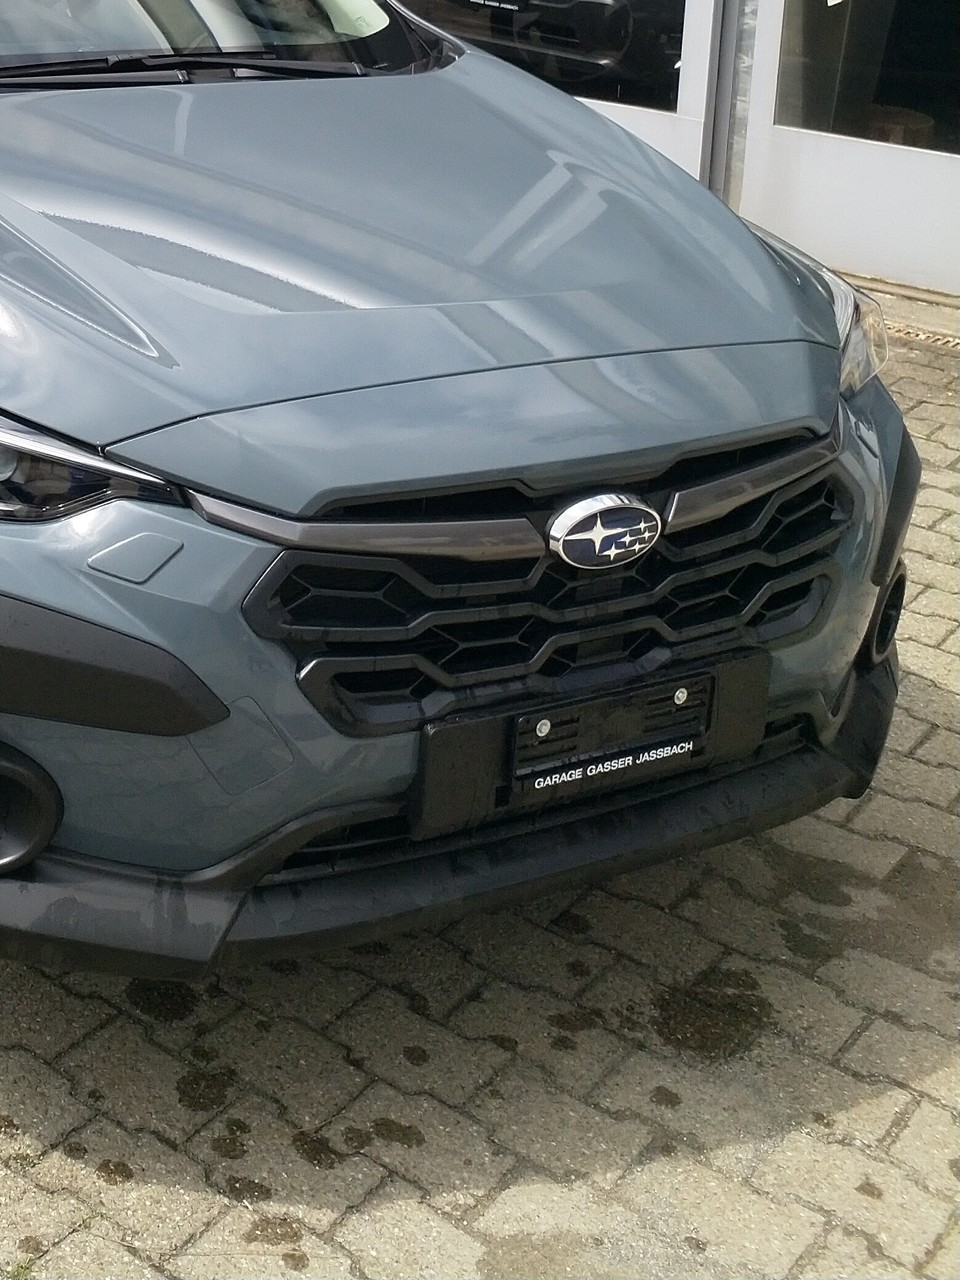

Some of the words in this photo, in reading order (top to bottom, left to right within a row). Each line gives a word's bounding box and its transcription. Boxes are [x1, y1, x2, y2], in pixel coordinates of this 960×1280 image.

[534, 768, 583, 789] GARAGE
[586, 756, 633, 776] GASSER
[635, 741, 694, 764] JASSBACH
